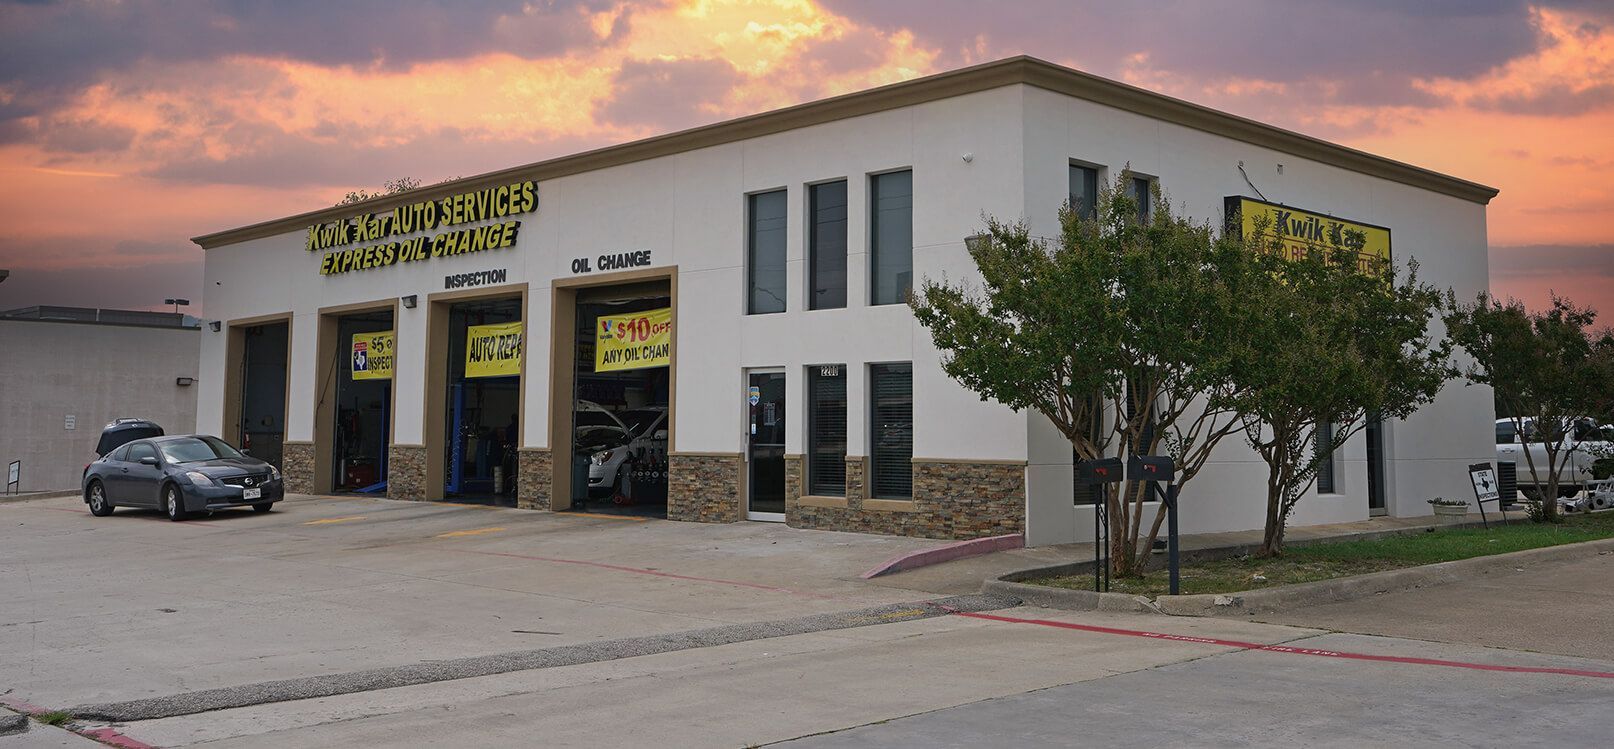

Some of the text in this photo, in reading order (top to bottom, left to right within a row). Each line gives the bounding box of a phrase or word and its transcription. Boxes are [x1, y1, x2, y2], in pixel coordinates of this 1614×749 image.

[305, 181, 536, 252] Kwik Kar AUTO SERVICES
[1272, 209, 1325, 242] Kwik
[320, 221, 519, 276] EXPRESS OIL CHANGE
[572, 250, 651, 274] OIL CHANGE
[445, 269, 506, 289] INSPECTION
[617, 317, 671, 342] $10 OFF
[371, 336, 385, 353] $5
[469, 335, 496, 363] AUTO
[602, 348, 622, 365] ANY
[624, 347, 639, 361] OIL
[642, 343, 669, 360] CHAN
[821, 366, 838, 376] 2200
